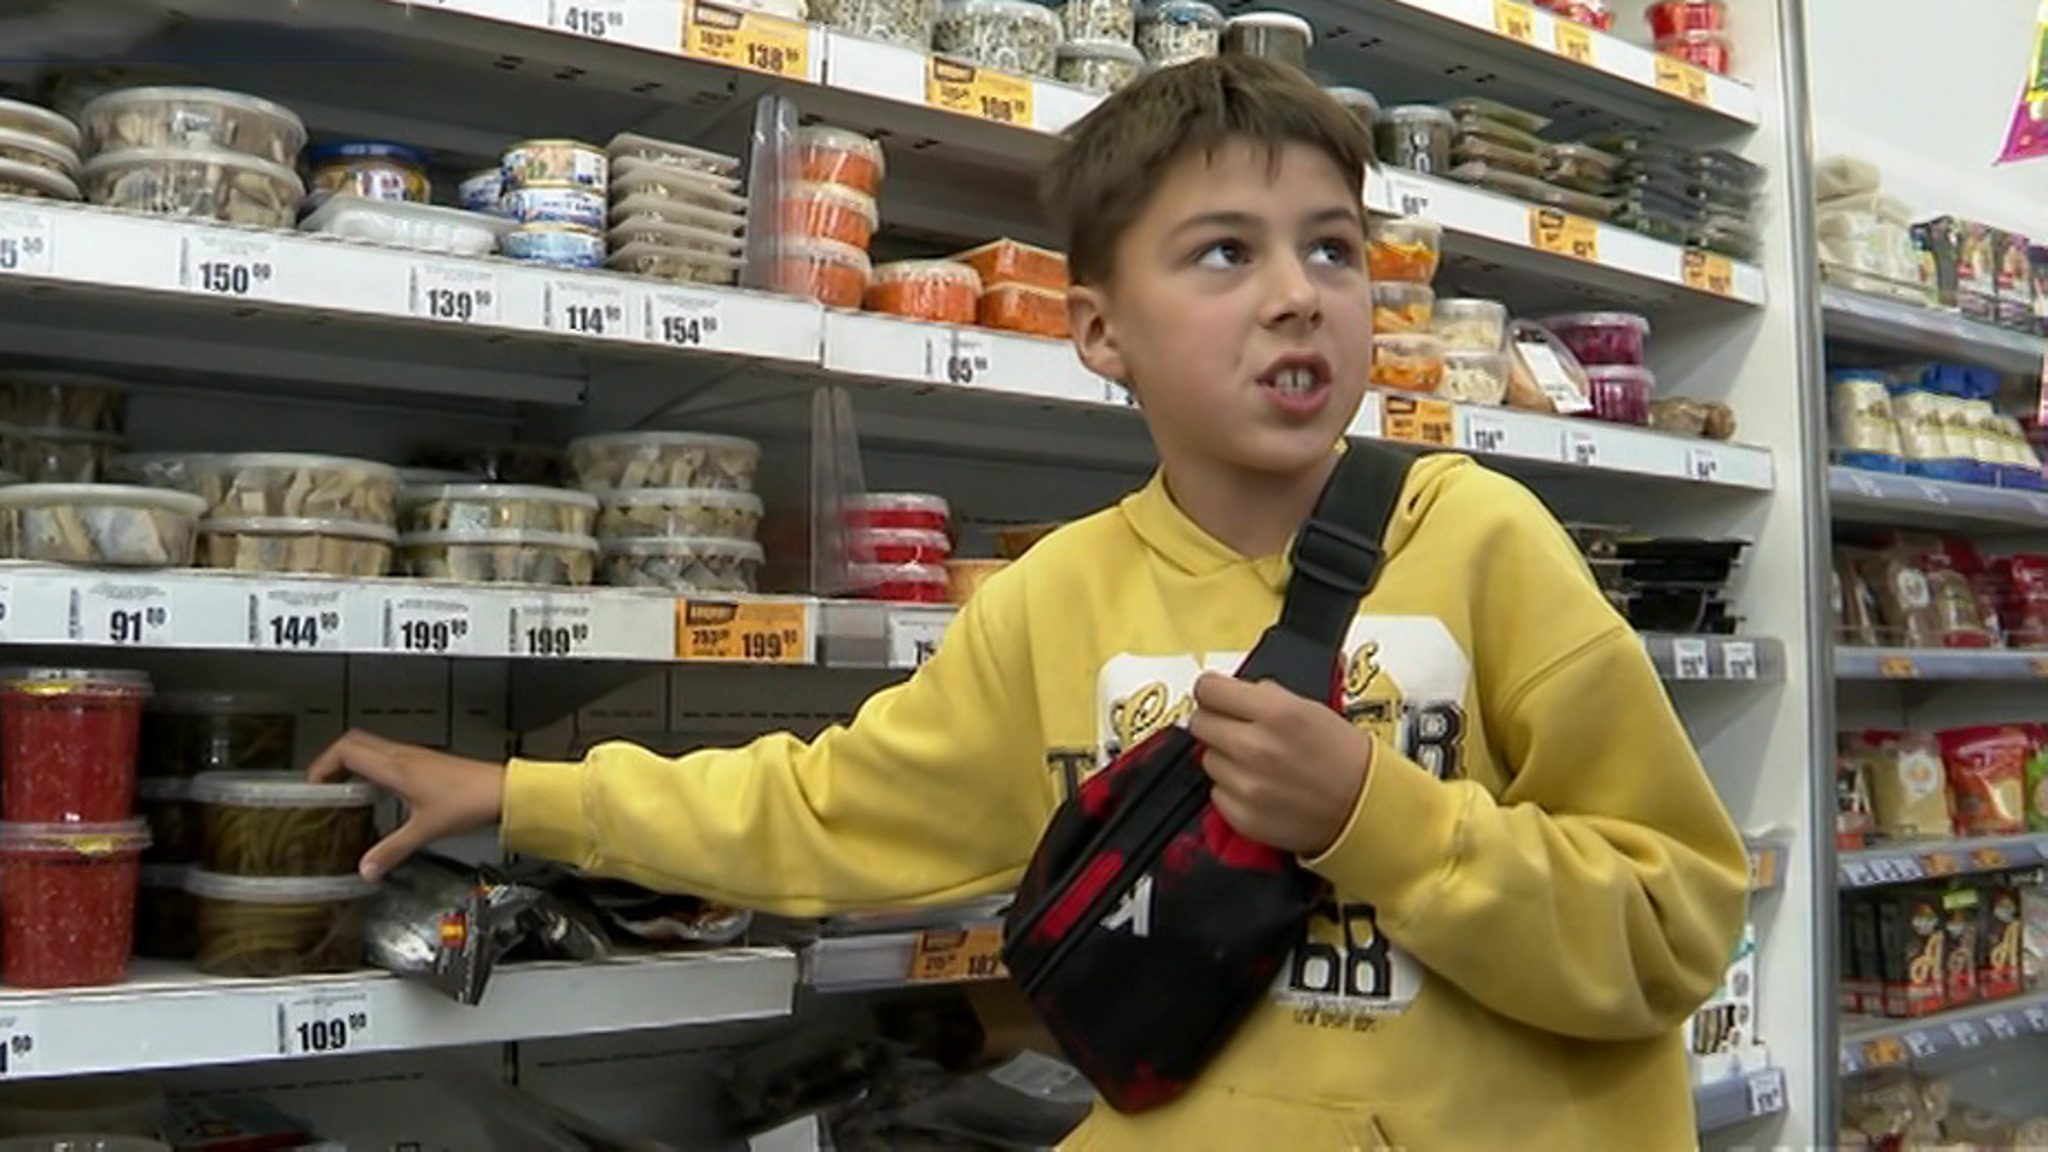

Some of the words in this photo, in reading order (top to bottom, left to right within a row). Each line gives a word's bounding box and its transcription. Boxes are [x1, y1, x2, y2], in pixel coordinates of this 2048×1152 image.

[564, 6, 605, 35] 415
[199, 261, 249, 294] 150
[427, 288, 472, 320] 139
[566, 305, 603, 334] 114
[662, 315, 700, 344] 154
[110, 609, 142, 642] 91
[270, 614, 318, 646] 144
[401, 620, 448, 650] 199
[526, 626, 571, 655] 199
[741, 631, 782, 659] 199
[296, 1018, 347, 1051] 109
